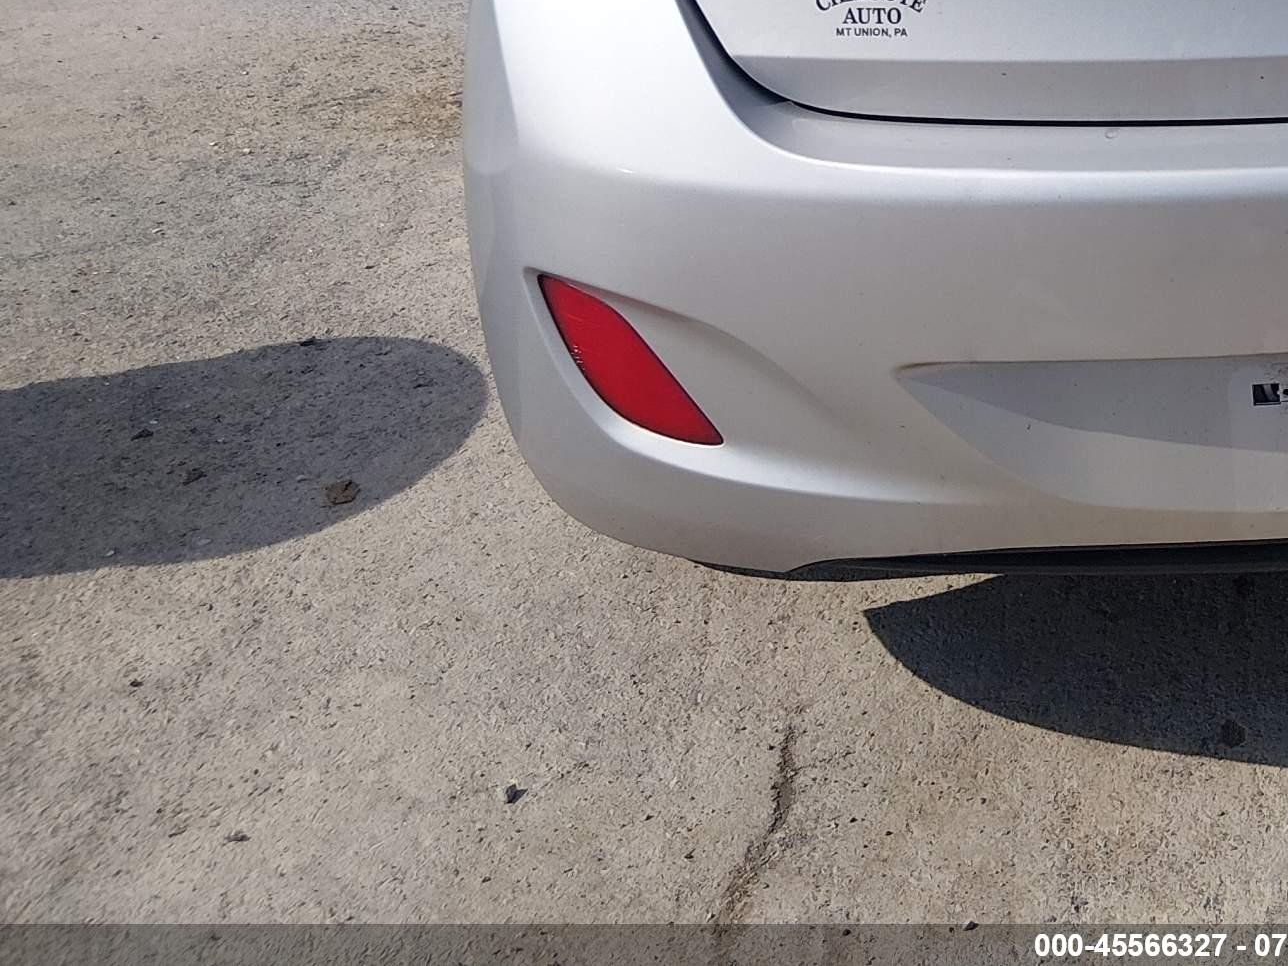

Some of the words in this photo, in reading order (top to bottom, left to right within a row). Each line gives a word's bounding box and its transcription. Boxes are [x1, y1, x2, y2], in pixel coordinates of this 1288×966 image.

[842, 7, 902, 25] AUTO
[836, 27, 852, 37] MT
[854, 27, 892, 38] UNION,
[893, 27, 908, 37] PA
